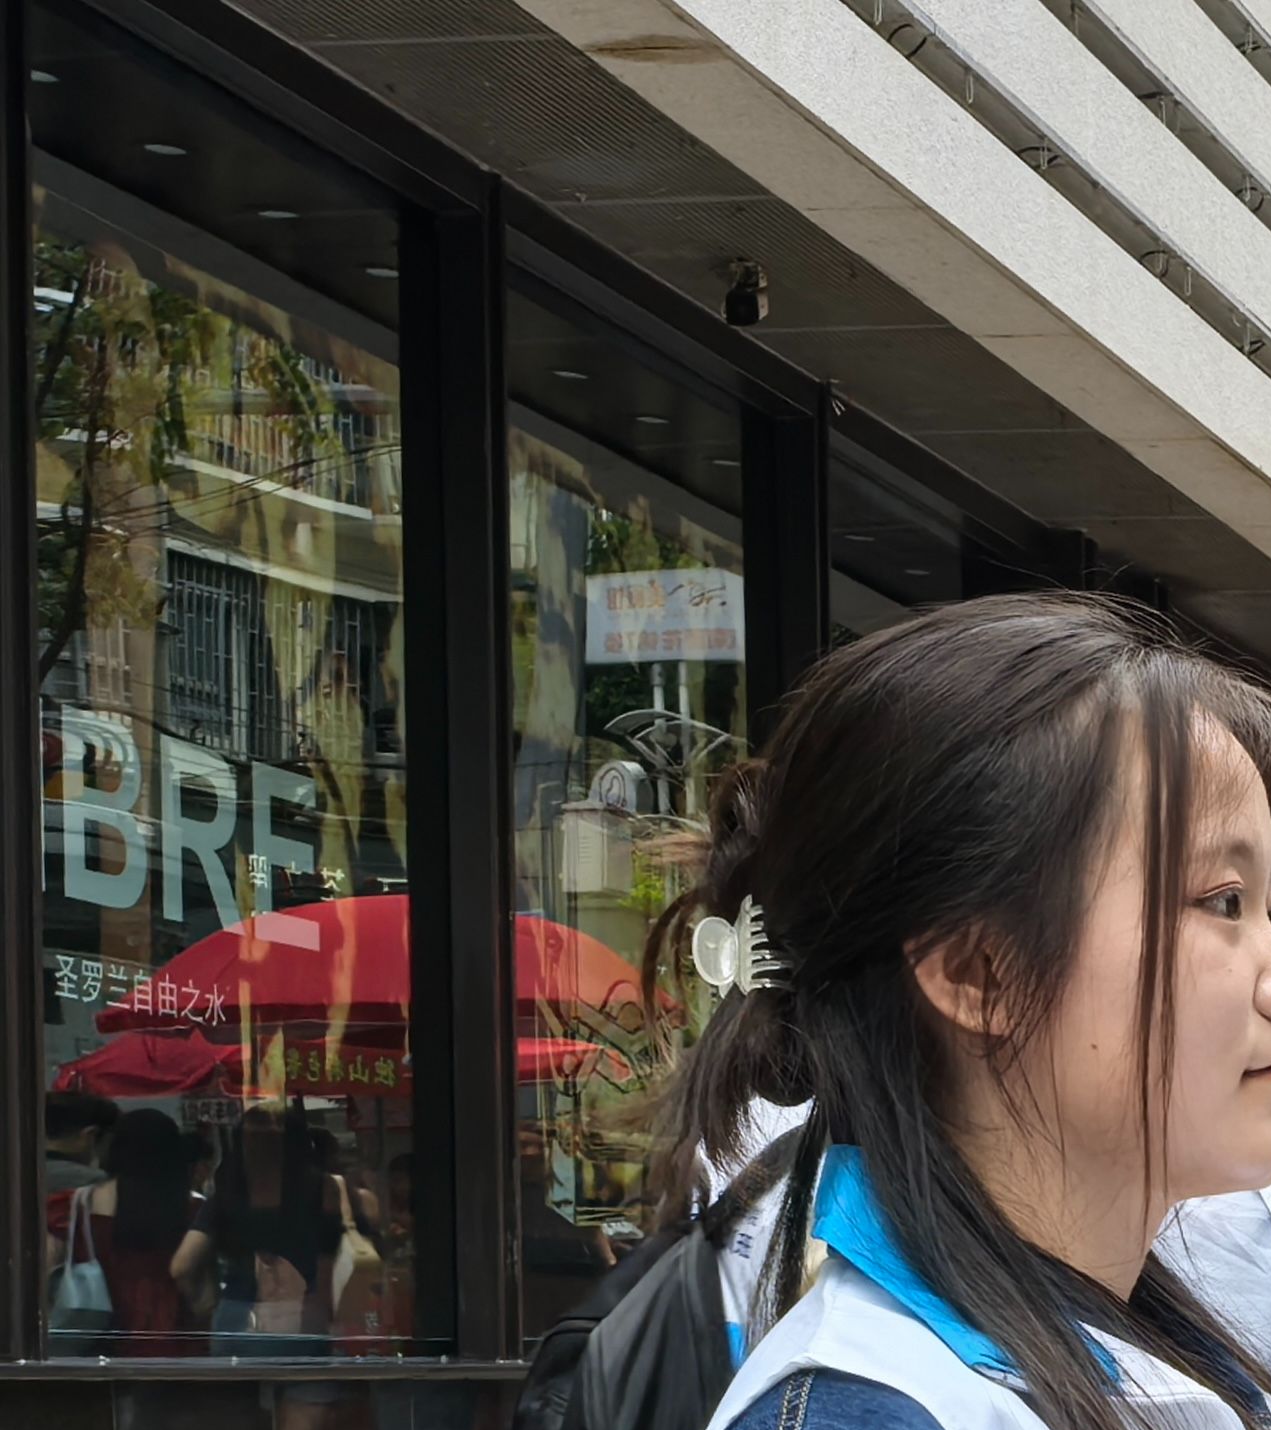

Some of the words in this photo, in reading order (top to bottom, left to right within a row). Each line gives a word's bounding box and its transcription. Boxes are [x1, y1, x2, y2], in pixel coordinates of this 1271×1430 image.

[39, 697, 320, 952] BRE
[55, 954, 227, 1027] 圣罗兰自由之水
